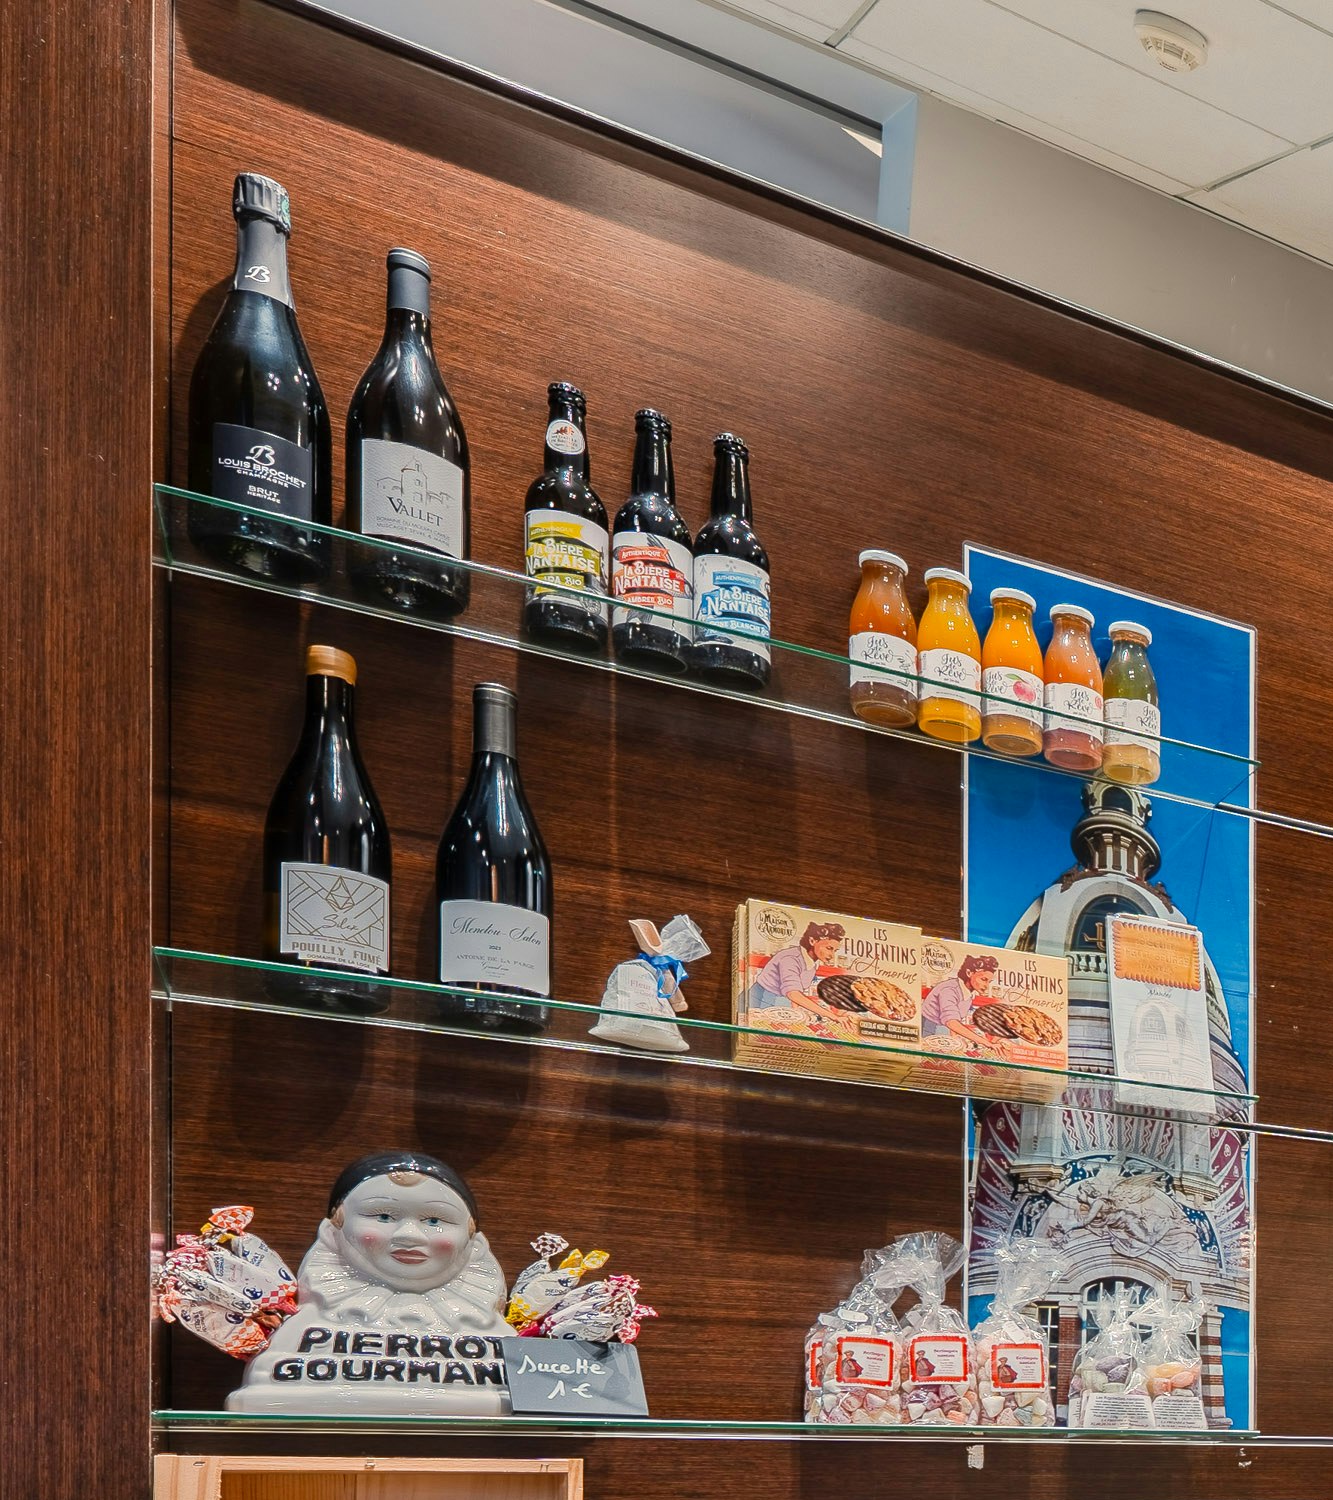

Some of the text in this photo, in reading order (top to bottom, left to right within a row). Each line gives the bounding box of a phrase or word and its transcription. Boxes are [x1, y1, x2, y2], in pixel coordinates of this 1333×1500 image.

[218, 457, 307, 489] LOUIS BROCHET
[237, 469, 289, 488] CHAMPAGNE
[248, 485, 279, 498] BRUT
[387, 496, 443, 527] VALLET
[615, 577, 681, 594] NANTAISE
[707, 597, 769, 621] NANTAISE
[320, 914, 361, 931] Silex
[873, 927, 888, 942] LES
[292, 941, 381, 966] POUILLY FUMÉ
[845, 938, 917, 966] FLORENTINS
[1024, 960, 1037, 973] LES
[998, 969, 1064, 996] FLORENTINS
[299, 1327, 502, 1359] PIERROT
[272, 1357, 507, 1386] GOURMAN
[518, 1353, 607, 1377] Sucette
